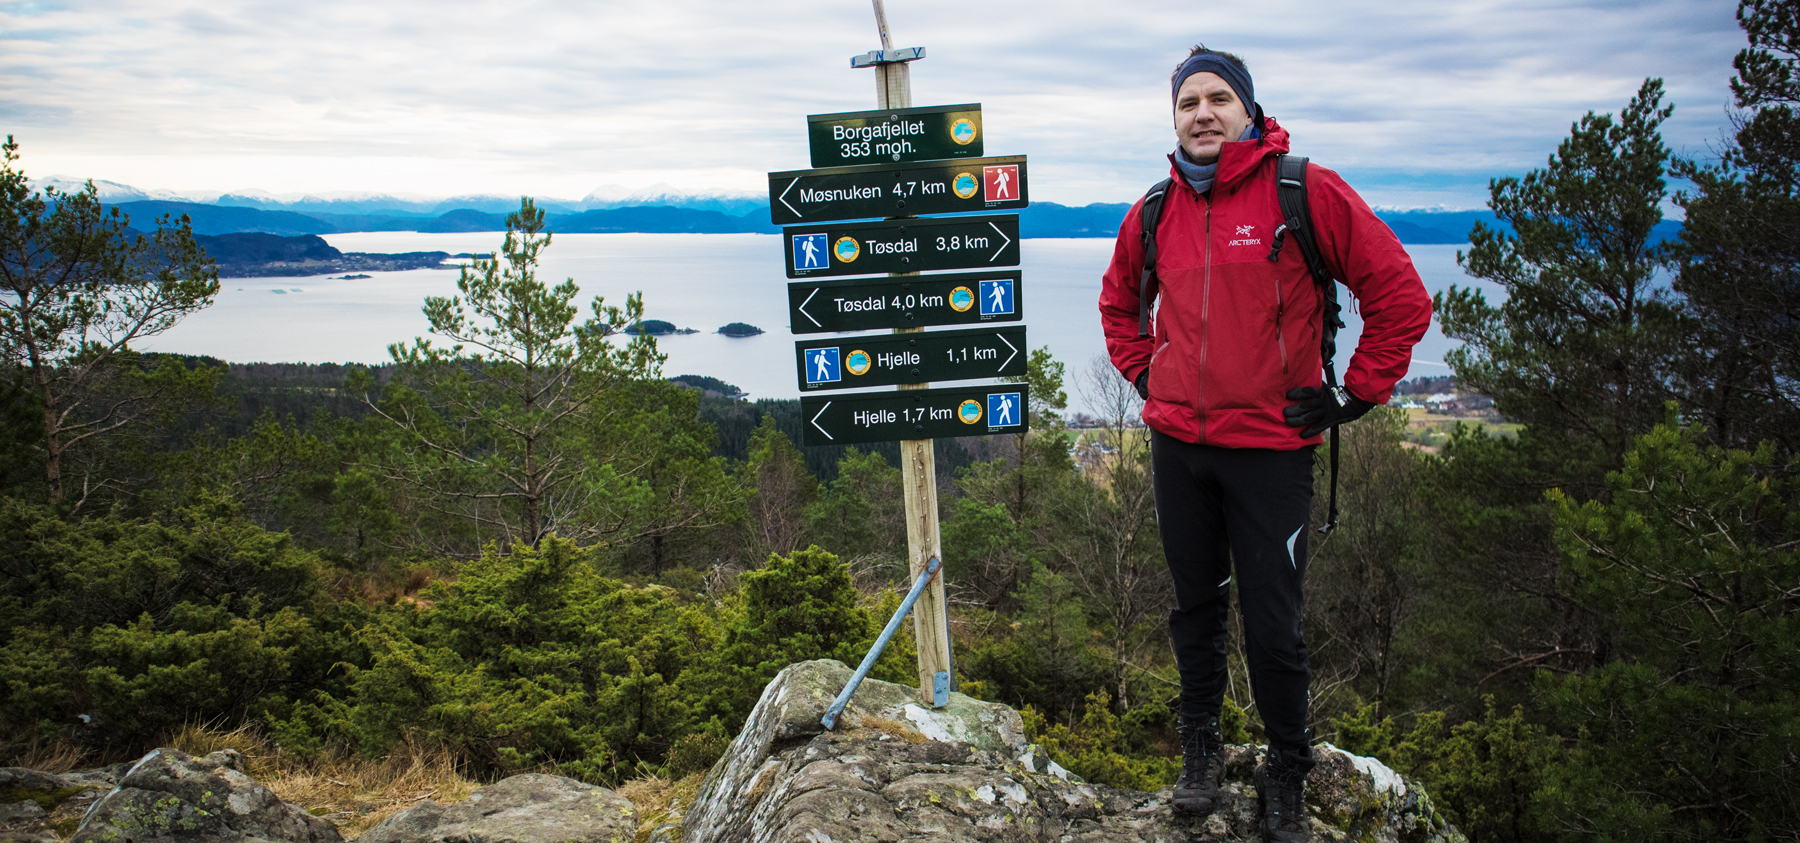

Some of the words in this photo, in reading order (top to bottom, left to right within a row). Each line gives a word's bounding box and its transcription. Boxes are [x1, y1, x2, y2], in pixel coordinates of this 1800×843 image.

[834, 121, 924, 139] Borgafjellet
[841, 142, 870, 157] 353
[876, 139, 917, 154] moh.
[801, 185, 881, 202] Møsnuken
[893, 182, 916, 197] 4,7
[922, 181, 945, 194] km
[866, 238, 917, 254] Tøsdal
[937, 236, 960, 251] 3,8
[965, 235, 988, 248] km
[834, 296, 885, 312] Tøsdal
[892, 295, 914, 310] 4,0
[920, 294, 942, 307] km
[878, 352, 919, 369] Hjelle
[947, 348, 966, 363] 1,1
[974, 347, 996, 359] km
[855, 410, 895, 427] Hjelle
[903, 408, 925, 423] 1,7
[930, 407, 952, 420] km
